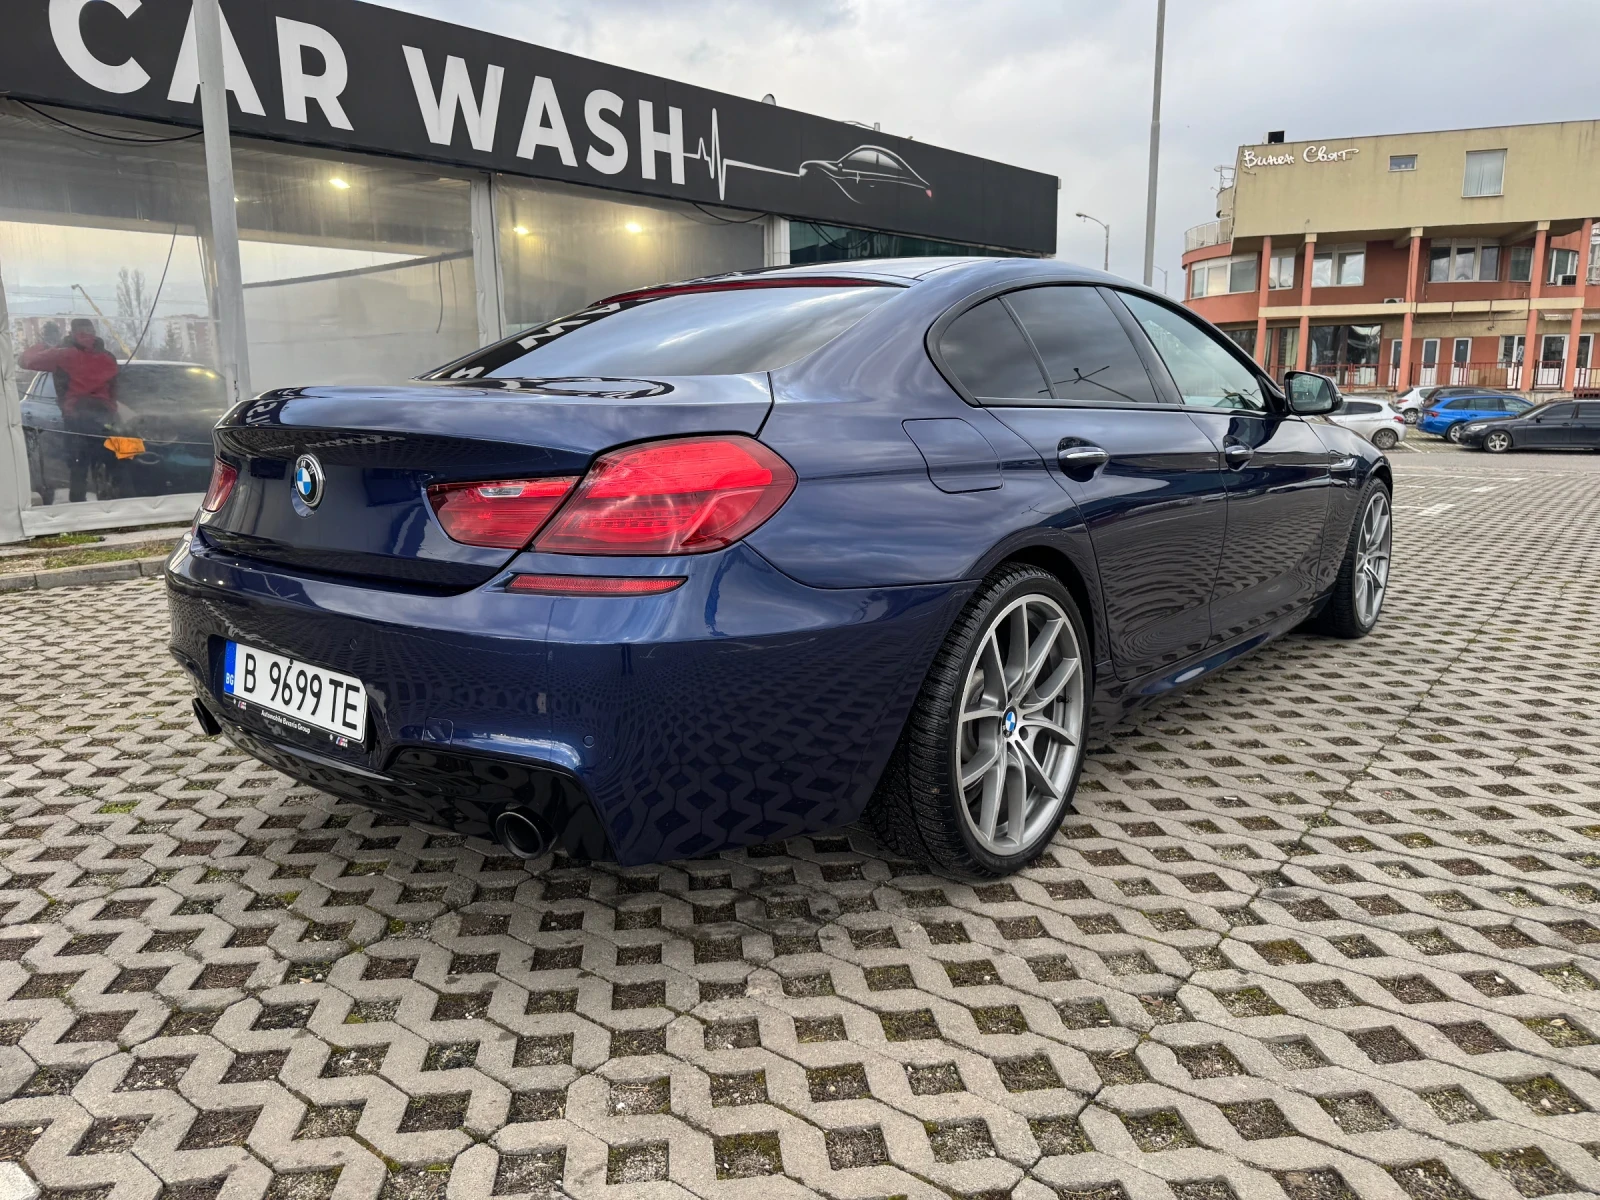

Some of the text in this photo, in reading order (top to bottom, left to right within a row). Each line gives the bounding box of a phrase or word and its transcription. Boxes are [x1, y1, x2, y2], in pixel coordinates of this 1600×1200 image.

[48, 0, 686, 185] CAR WASH
[1303, 146, 1360, 163] Свят
[225, 672, 235, 686] BG
[261, 710, 283, 724] Automobile
[298, 723, 311, 735] Group
